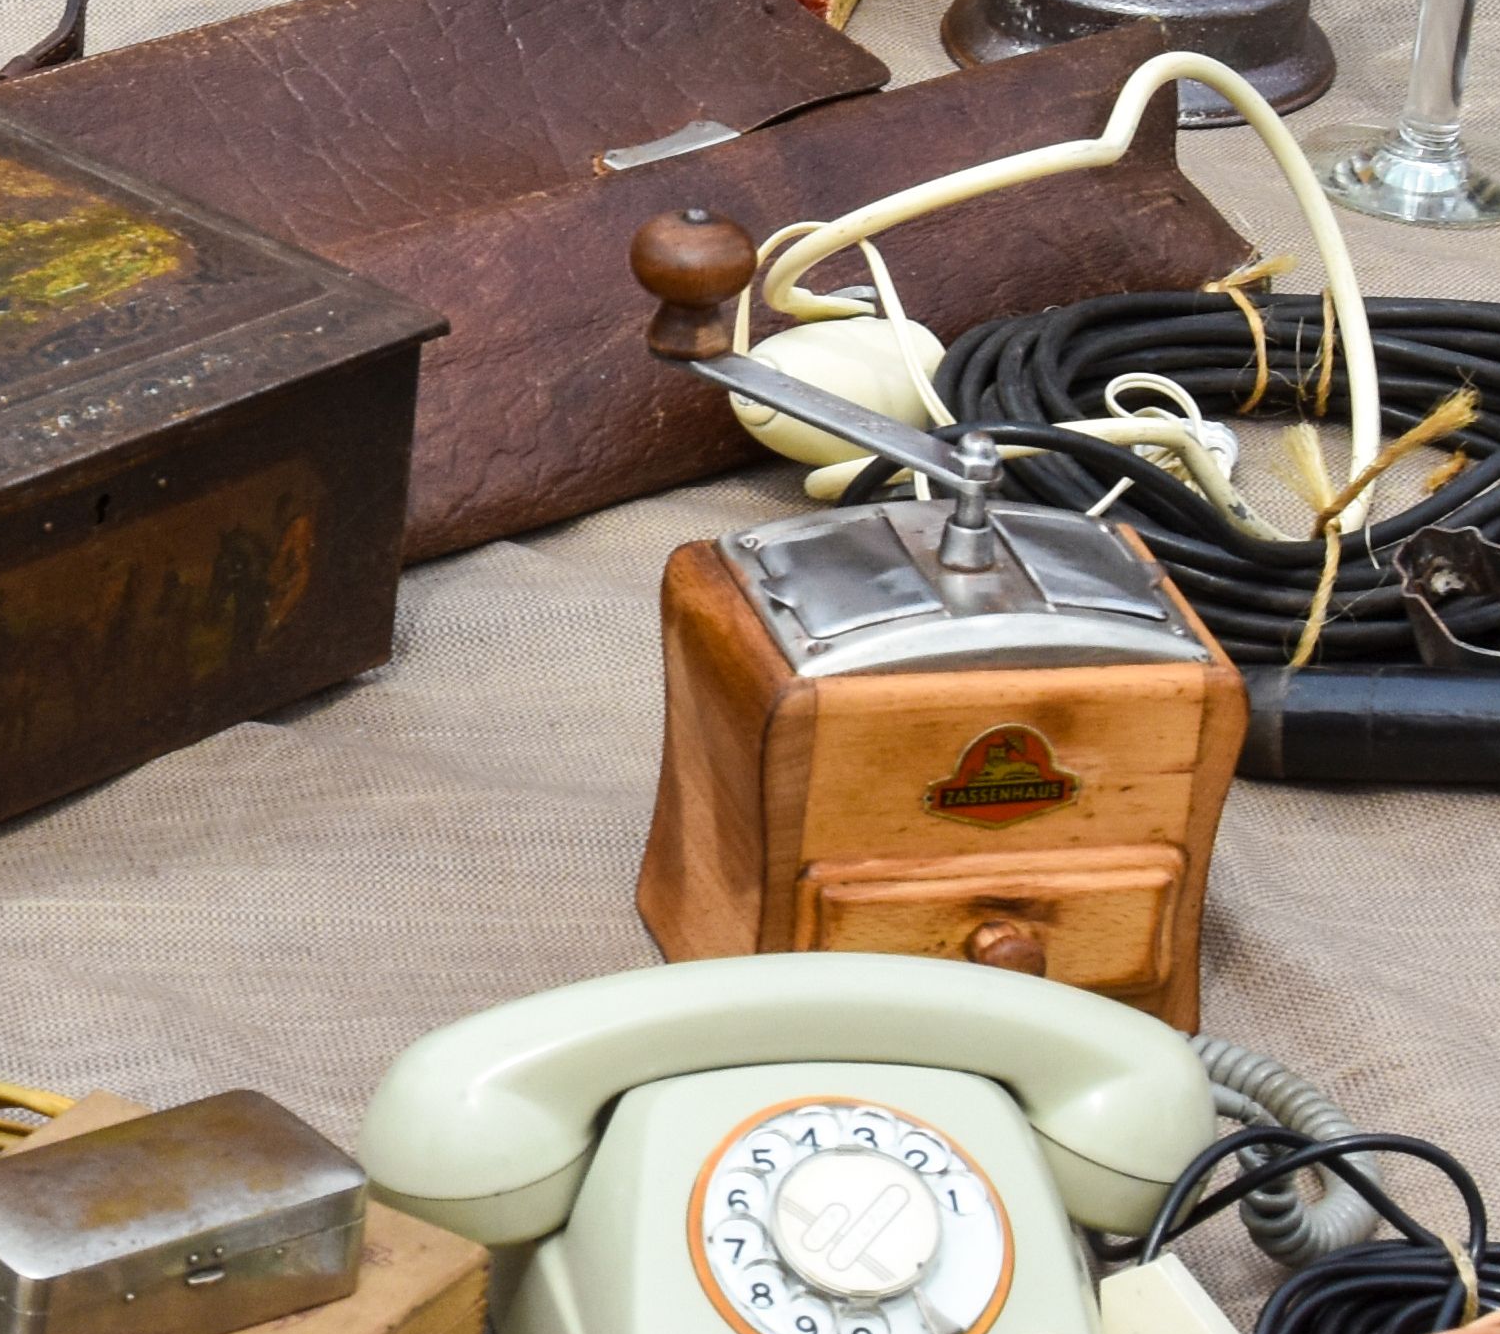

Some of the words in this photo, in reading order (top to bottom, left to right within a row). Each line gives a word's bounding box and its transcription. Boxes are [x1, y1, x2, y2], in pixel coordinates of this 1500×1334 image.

[944, 783, 1062, 806] ZASSENHAUS
[853, 1127, 878, 1148] 3
[751, 1149, 776, 1171] 5
[727, 1189, 749, 1213] 6
[947, 1189, 960, 1213] 1
[724, 1238, 746, 1264] 7
[750, 1282, 774, 1309] 8
